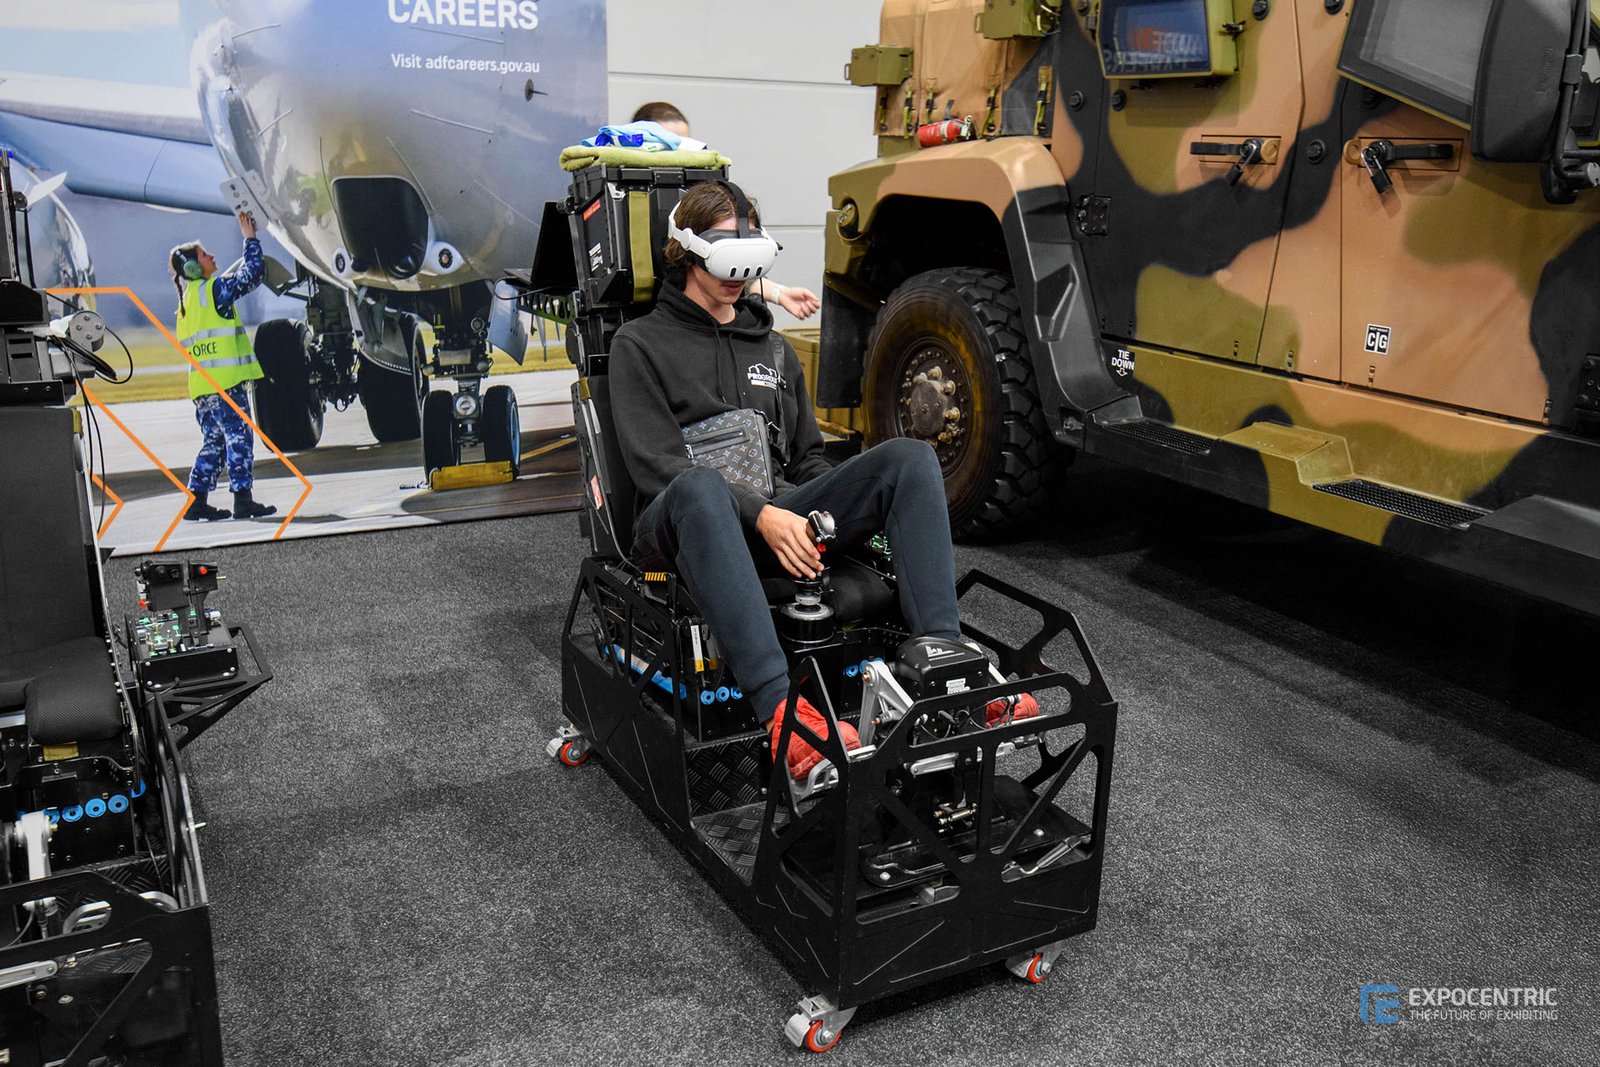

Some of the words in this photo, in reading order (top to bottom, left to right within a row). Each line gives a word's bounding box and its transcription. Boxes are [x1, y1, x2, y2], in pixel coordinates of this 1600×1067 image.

[388, 0, 539, 30] CAREERS
[391, 53, 422, 69] Visit
[425, 55, 540, 74] adfcareers.gov.au
[188, 342, 217, 358] ORCE
[1118, 349, 1130, 360] TIE
[1111, 357, 1135, 370] DOWN
